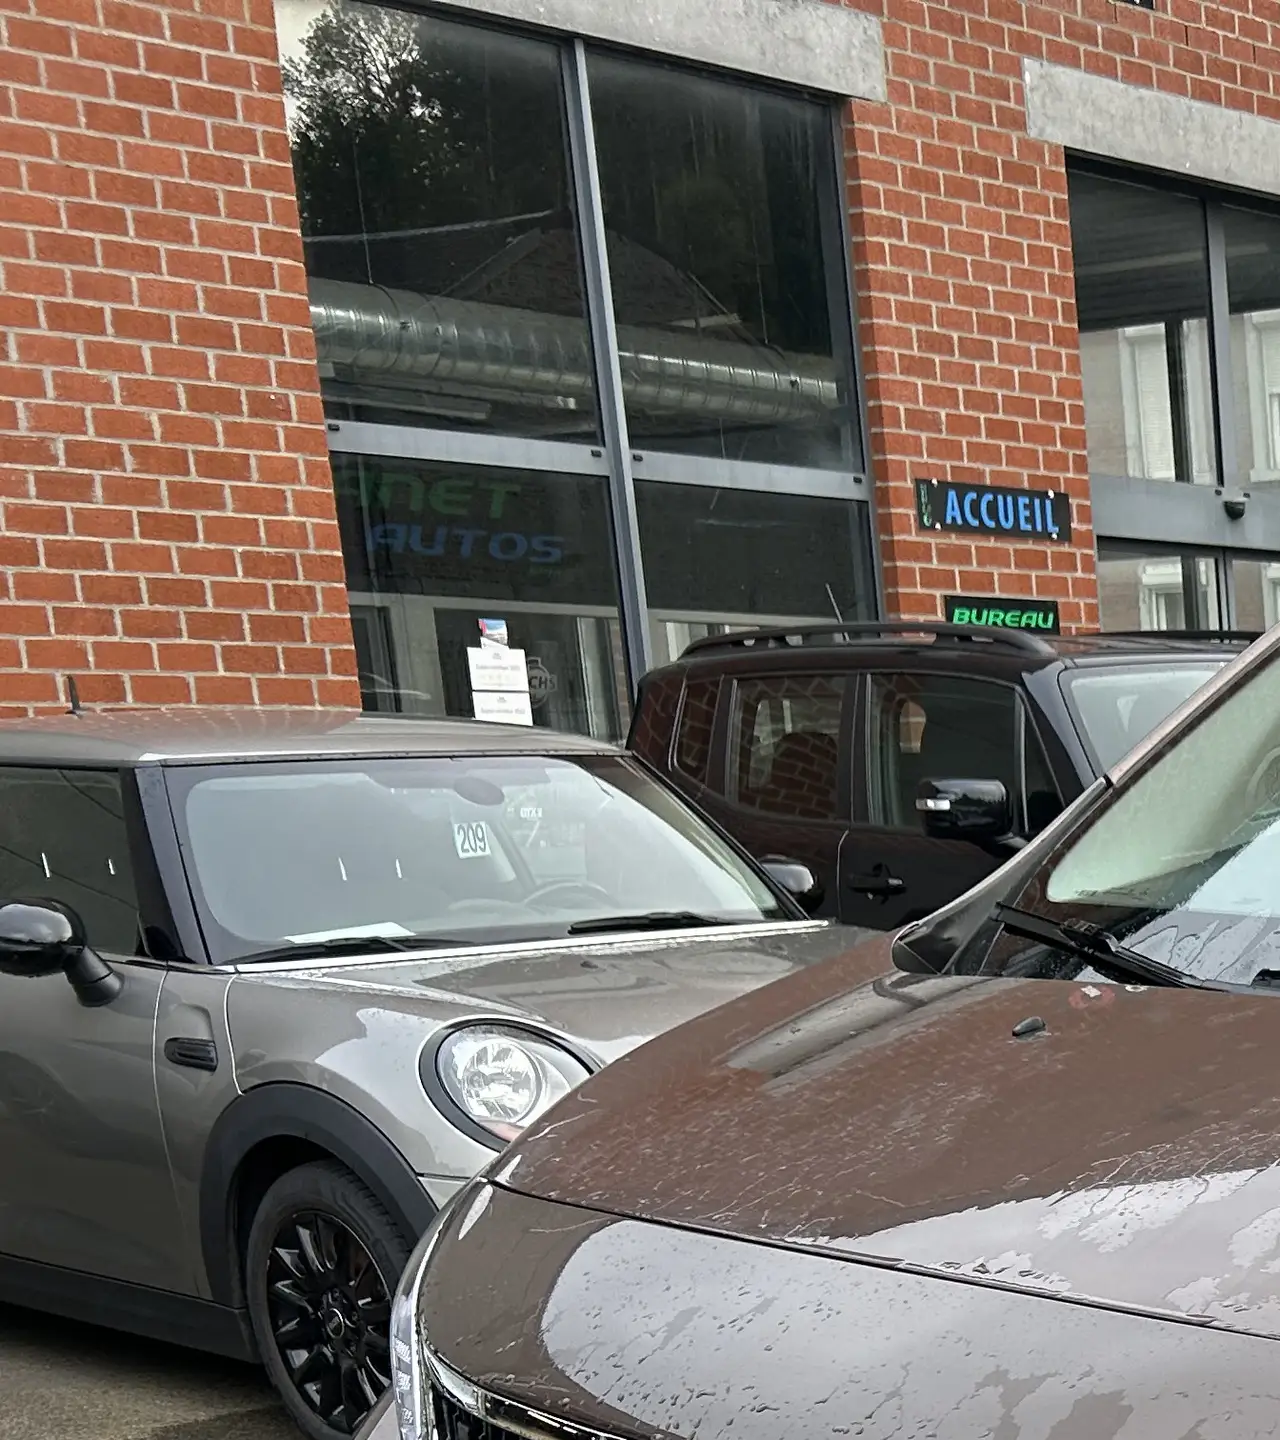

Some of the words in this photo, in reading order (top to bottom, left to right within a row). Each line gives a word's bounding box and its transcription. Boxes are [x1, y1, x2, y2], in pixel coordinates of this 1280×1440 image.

[945, 488, 1060, 534] ACCUEIL
[370, 520, 566, 564] AUTOS
[952, 607, 1054, 629] BUREAU
[456, 822, 487, 854] 209
